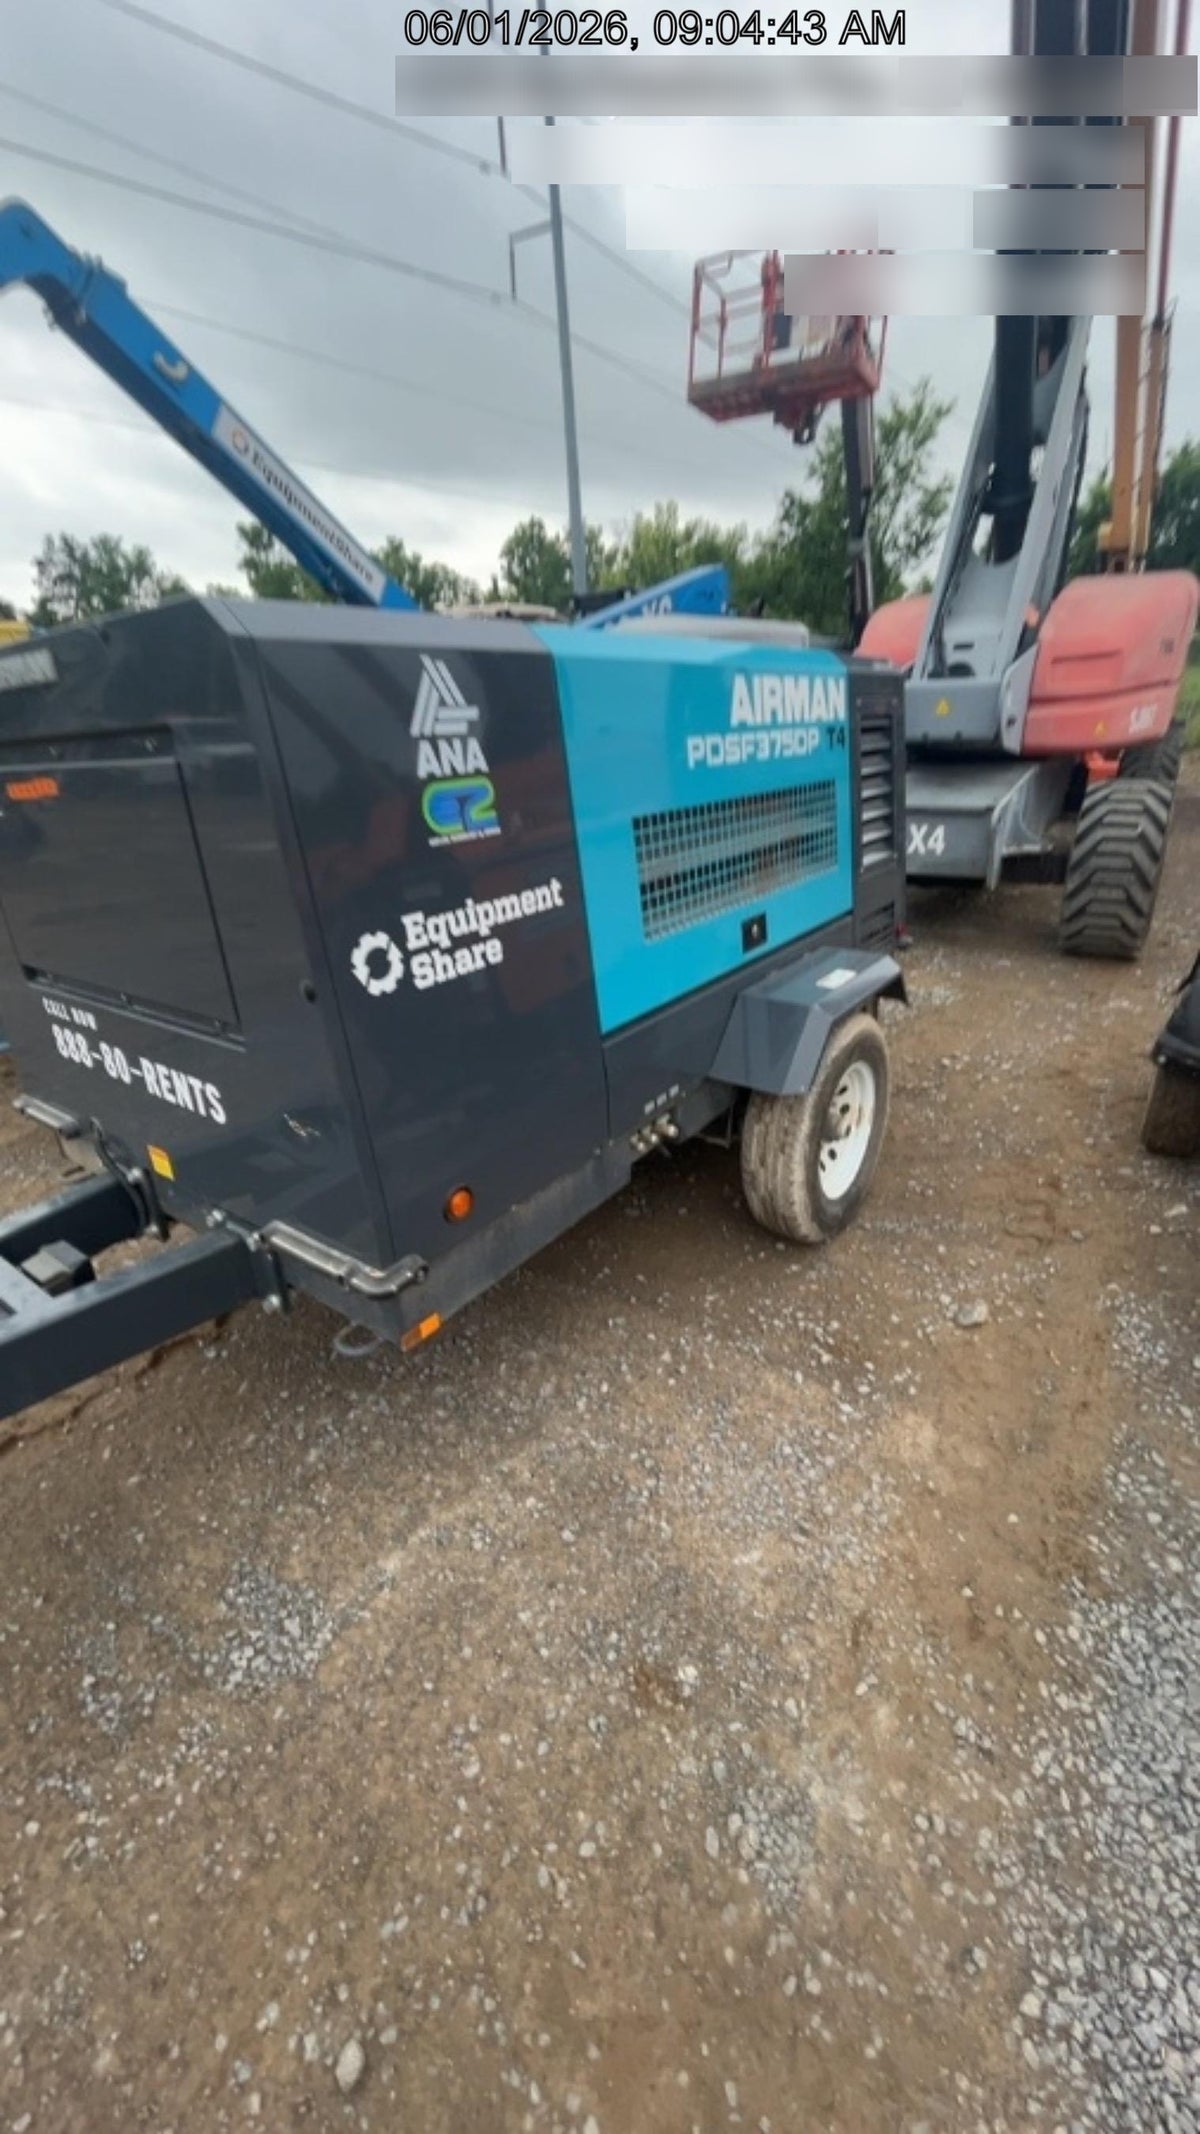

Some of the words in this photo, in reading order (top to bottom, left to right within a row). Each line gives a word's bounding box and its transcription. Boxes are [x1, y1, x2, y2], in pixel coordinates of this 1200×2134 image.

[730, 673, 845, 728] AIRMAN
[417, 737, 490, 779] ANA
[827, 726, 845, 749] T4
[906, 823, 945, 856] X4
[401, 877, 564, 951] Equipment
[410, 938, 504, 990] Share
[52, 1023, 227, 1125] 888-80-RENTS
